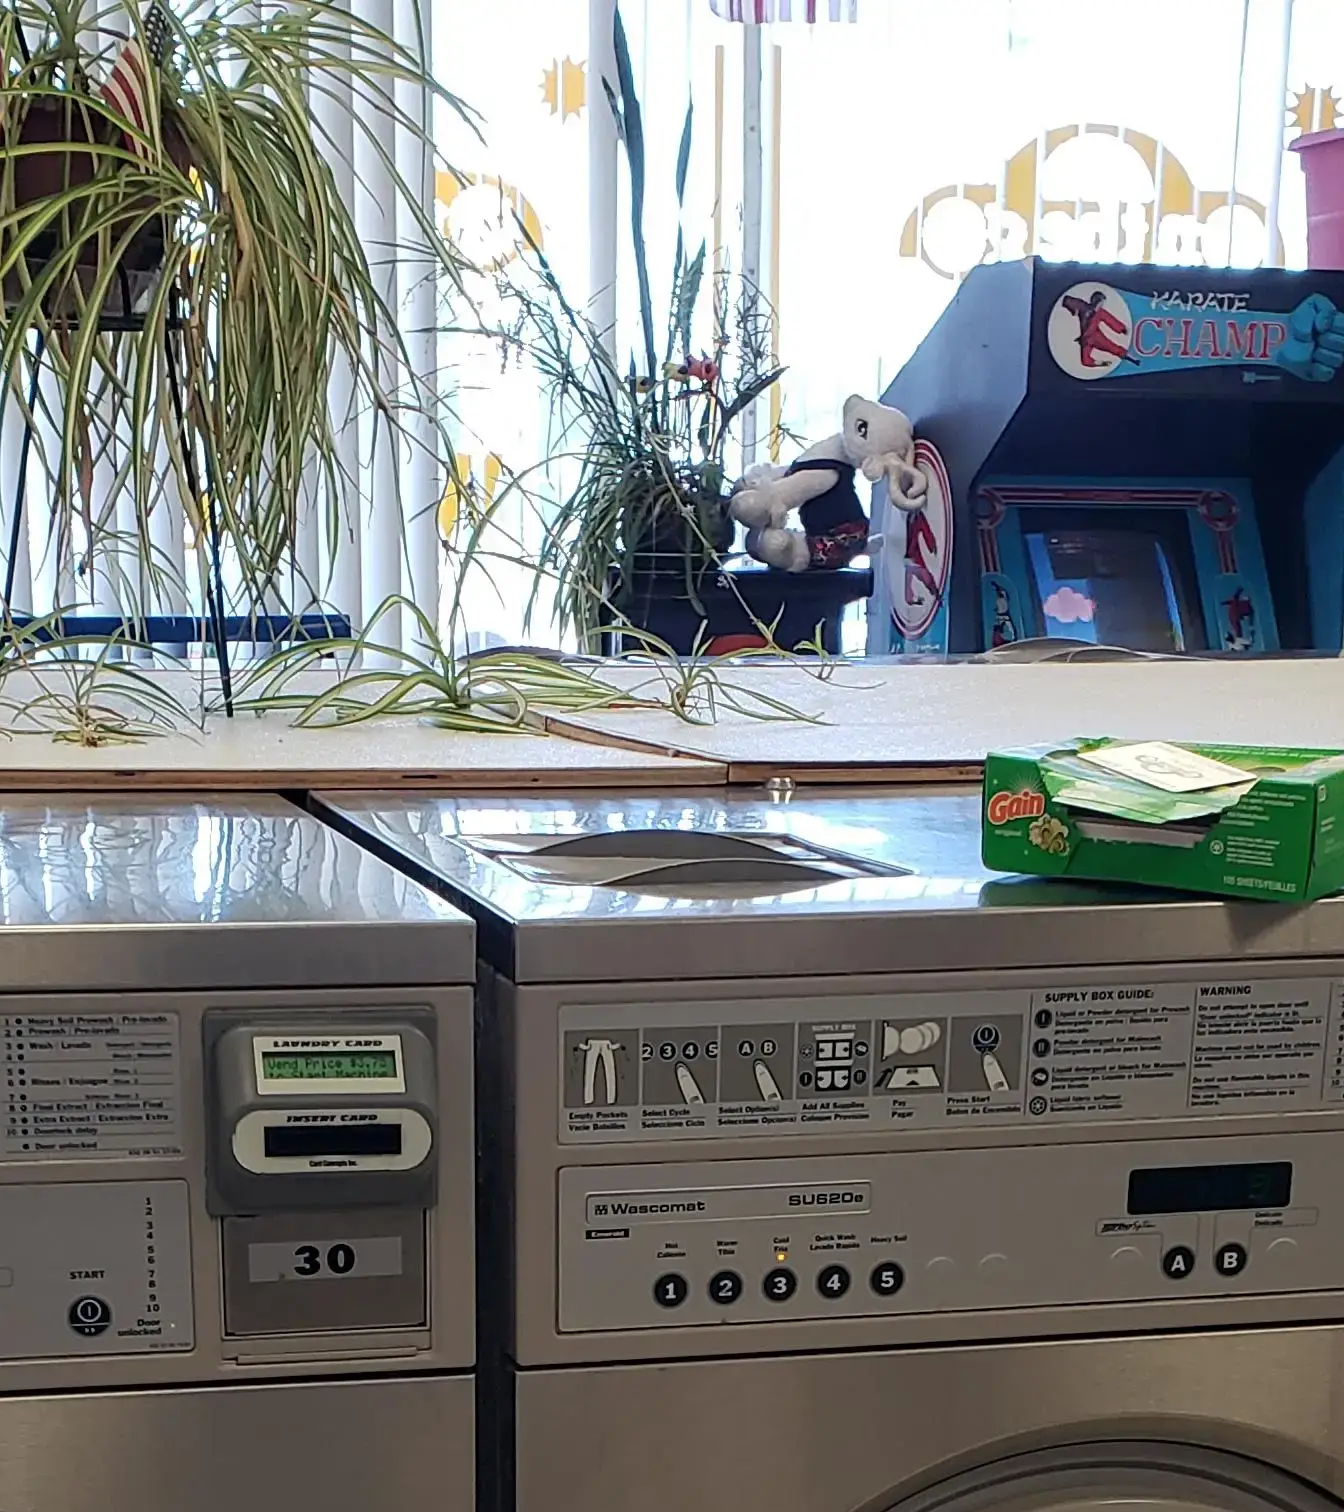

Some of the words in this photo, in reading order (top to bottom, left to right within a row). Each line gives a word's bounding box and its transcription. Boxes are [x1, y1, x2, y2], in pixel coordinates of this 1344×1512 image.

[1150, 290, 1250, 313] KARATE
[1132, 317, 1287, 360] CHAMP
[988, 789, 1046, 825] Gain
[1044, 992, 1088, 1003] SUPPLY
[1091, 990, 1114, 1001] BOX
[1118, 989, 1154, 999] GUIDE:
[1200, 985, 1252, 997] WARNING
[273, 1040, 340, 1048] LAUNDRY
[268, 1058, 298, 1070] Vend
[306, 1057, 343, 1069] Price
[286, 1114, 337, 1123] INSERT
[340, 1112, 379, 1122] CARD
[568, 1112, 594, 1120] Empty
[596, 1111, 628, 1119] Pockets
[642, 1109, 667, 1117] Select
[669, 1109, 690, 1117] Cycle
[788, 1192, 864, 1206] SU620e
[610, 1200, 707, 1215] Wascomat
[293, 1243, 356, 1275] 30
[1170, 1254, 1187, 1272] A
[1223, 1252, 1238, 1269] B
[69, 1269, 106, 1280] START
[664, 1283, 677, 1299] 1
[718, 1280, 733, 1297] 2
[773, 1277, 788, 1293] 3
[826, 1274, 841, 1290] 4
[880, 1271, 895, 1287] 5
[146, 1303, 160, 1313] 10
[137, 1319, 161, 1327] Door
